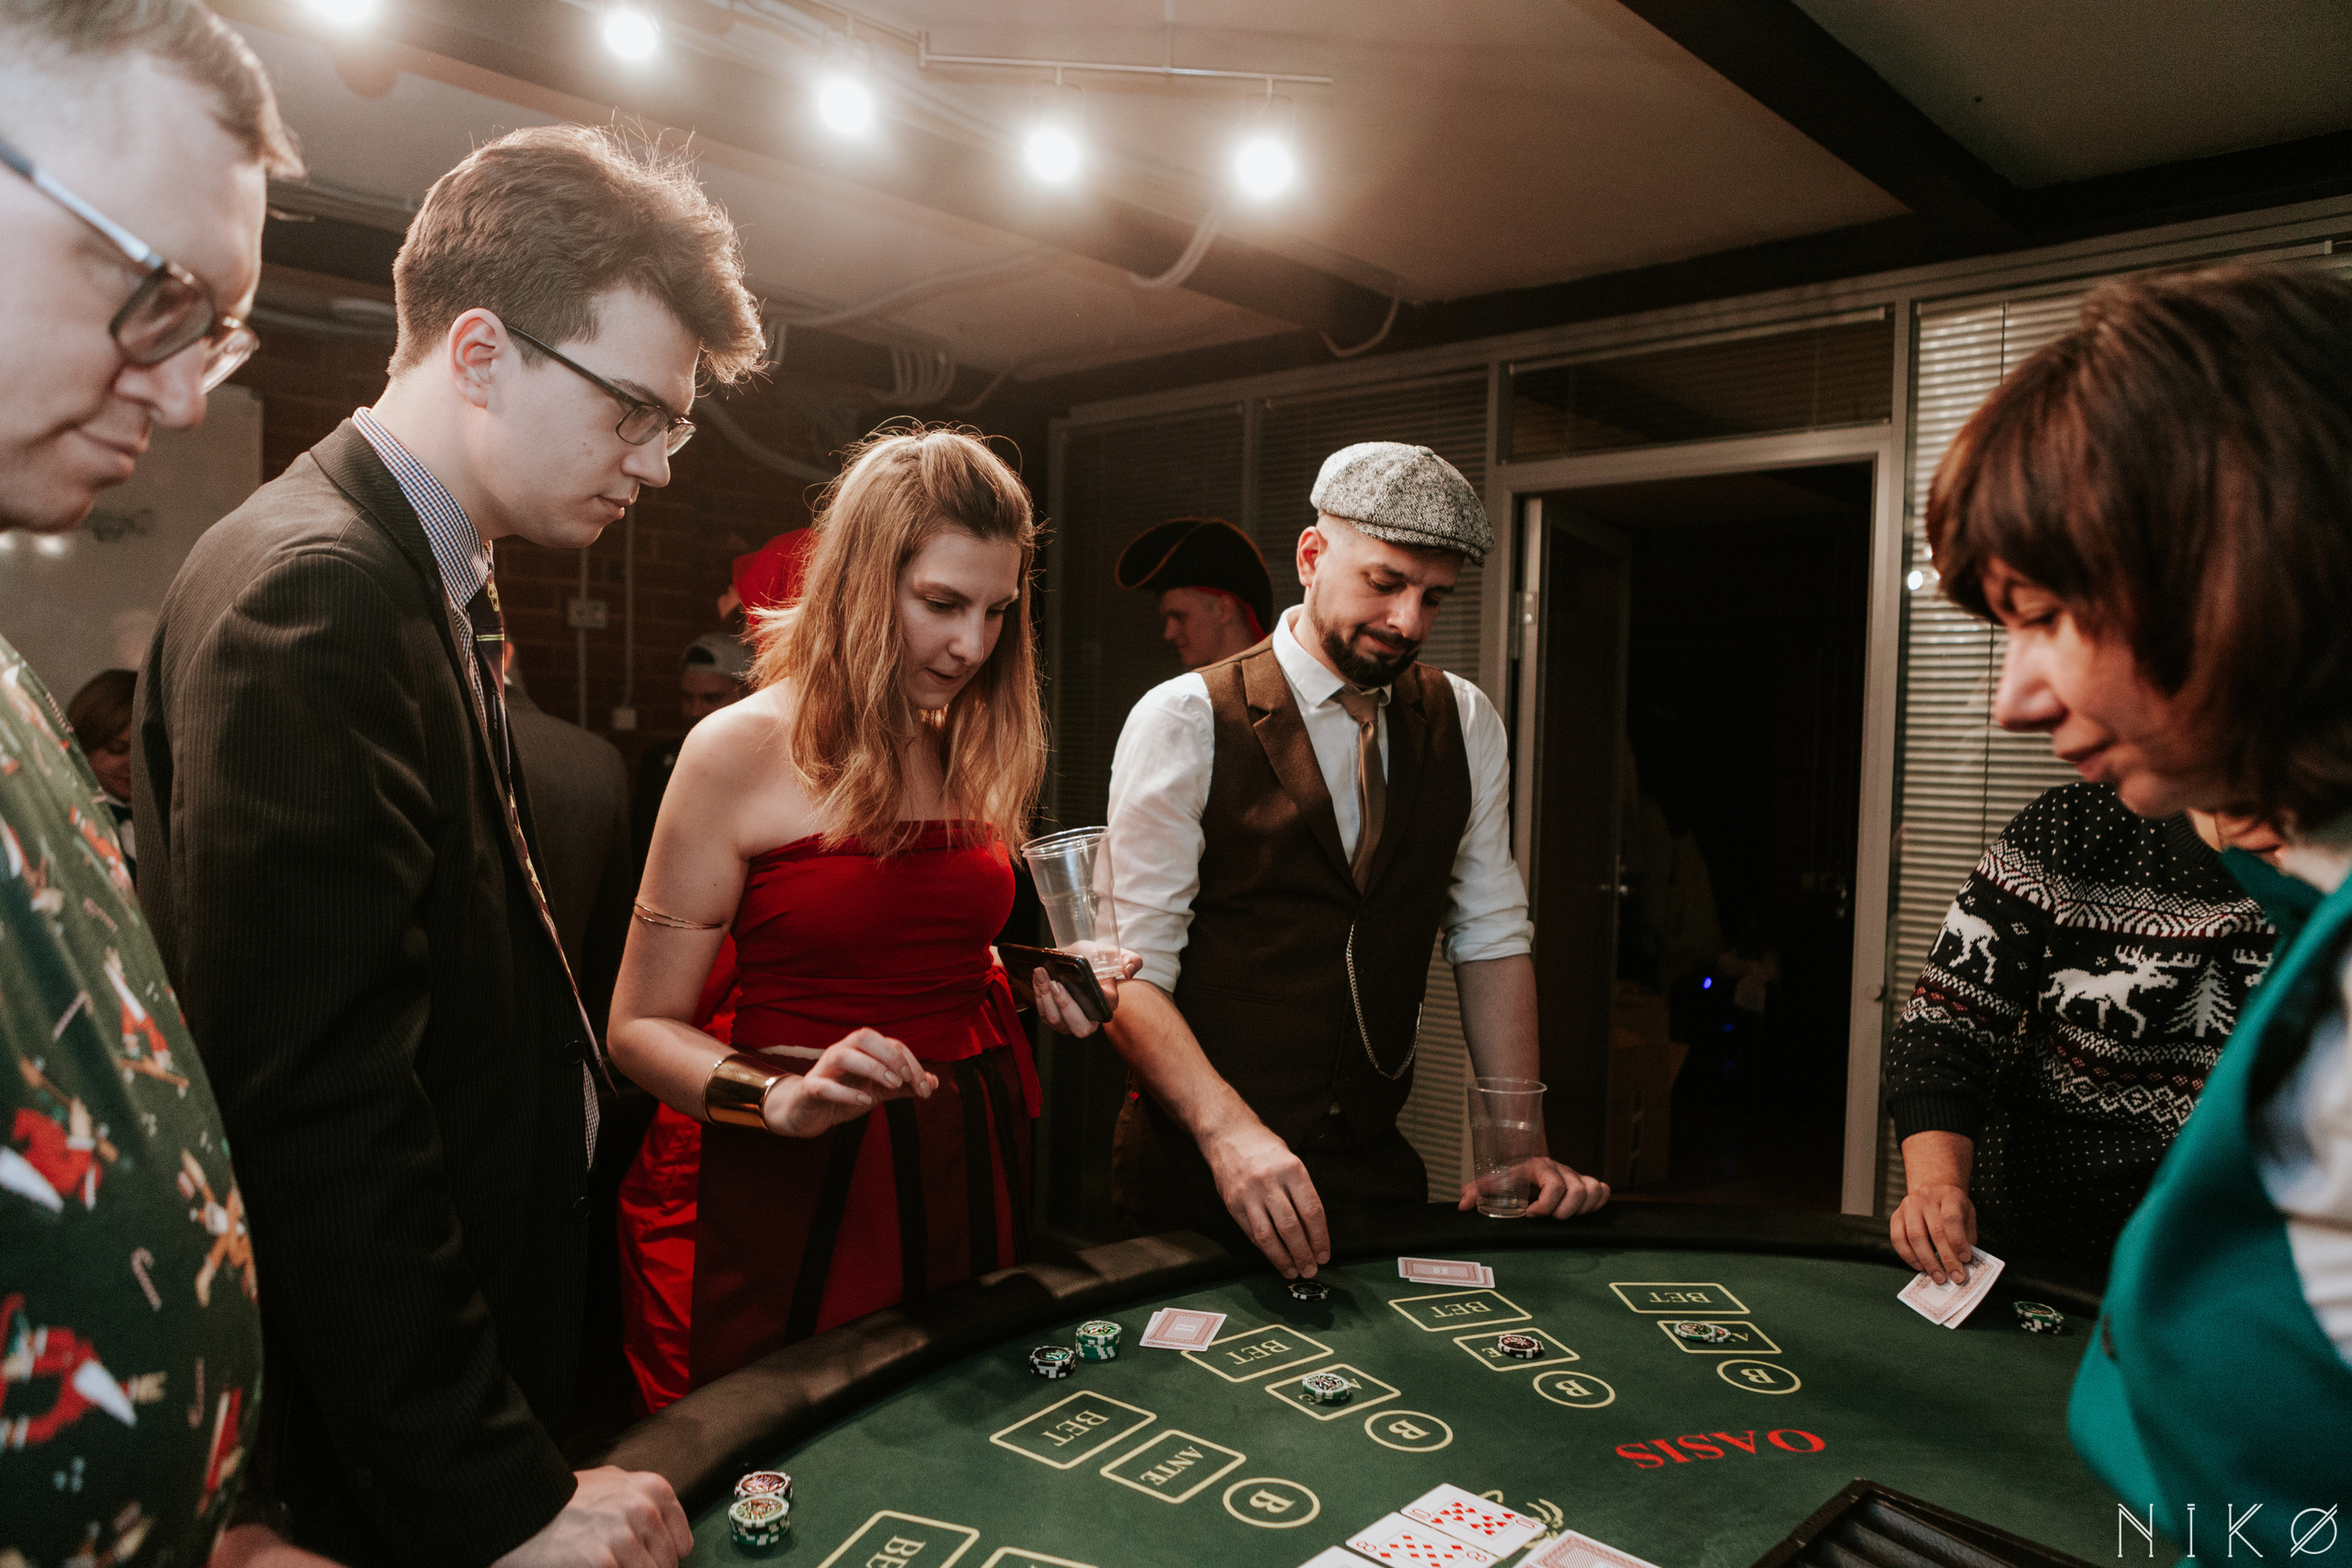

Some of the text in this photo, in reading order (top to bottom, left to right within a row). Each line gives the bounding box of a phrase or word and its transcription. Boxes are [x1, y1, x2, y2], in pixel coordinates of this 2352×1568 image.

[1649, 1292, 1713, 1303] BET
[1430, 1301, 1493, 1318] BET
[1226, 1338, 1294, 1366] BET
[1740, 1368, 1778, 1383] B
[1555, 1379, 1594, 1397] B
[1041, 1409, 1111, 1448] BET
[1387, 1419, 1430, 1440] B
[1615, 1428, 1826, 1470] OASIS
[1139, 1445, 1204, 1486] ANTE
[1249, 1488, 1295, 1514] B
[865, 1534, 927, 1568] BE
[1355, 1540, 1377, 1552] 8
[1466, 1551, 1488, 1562] 8
